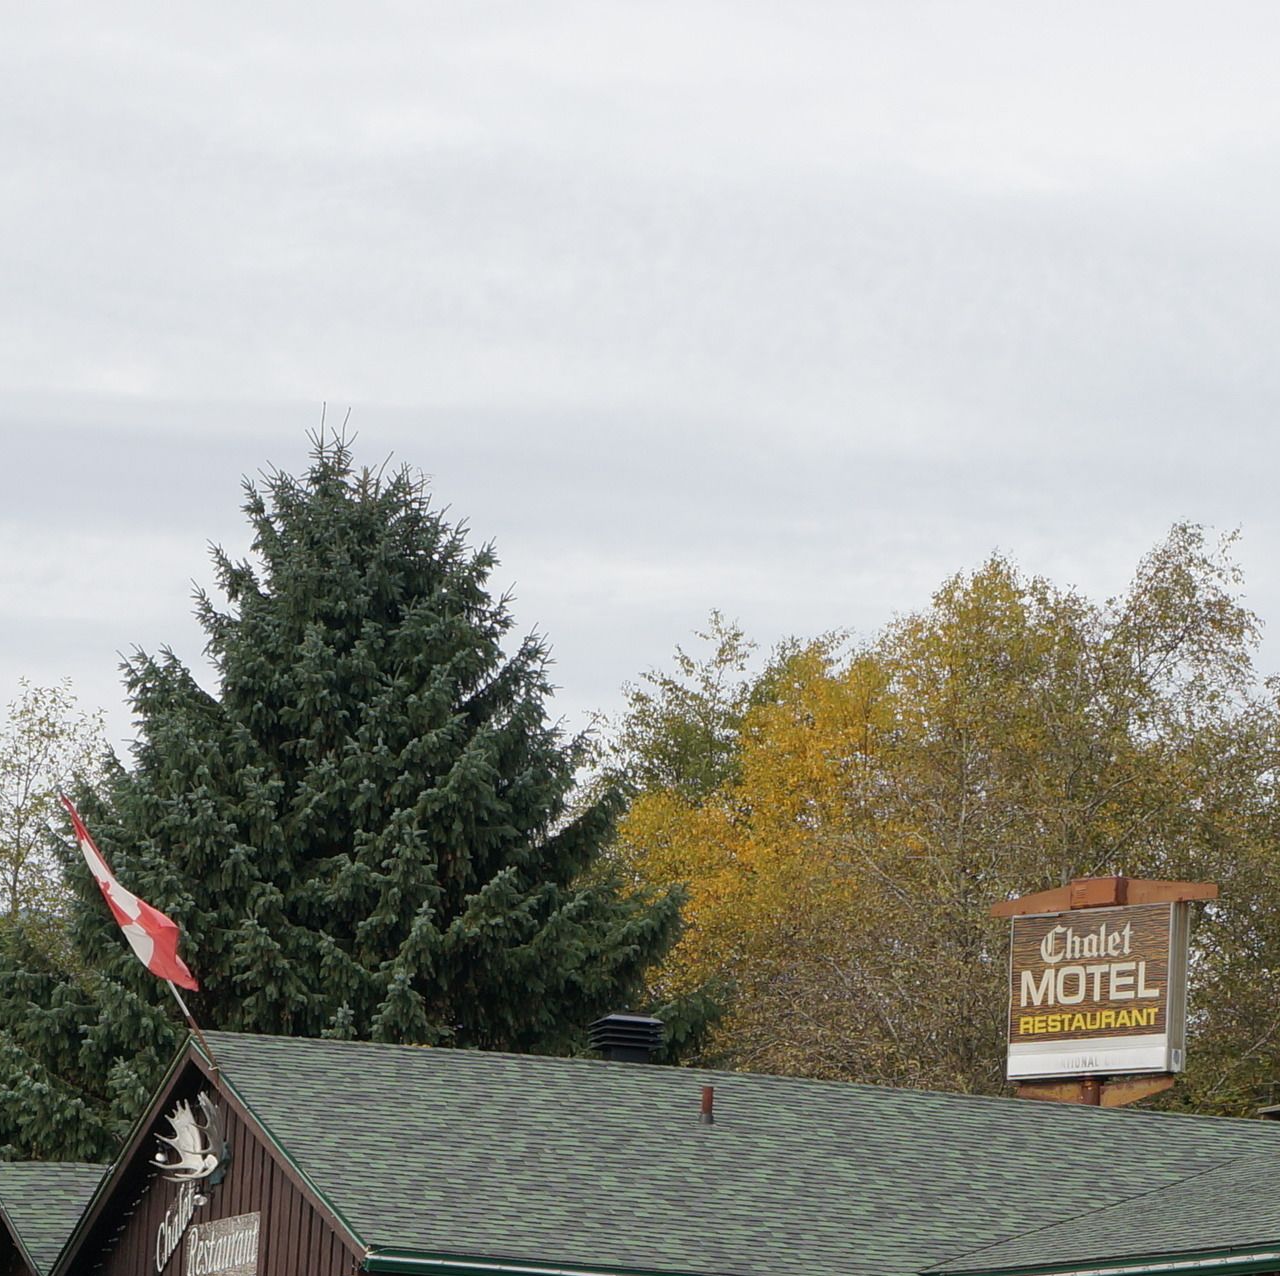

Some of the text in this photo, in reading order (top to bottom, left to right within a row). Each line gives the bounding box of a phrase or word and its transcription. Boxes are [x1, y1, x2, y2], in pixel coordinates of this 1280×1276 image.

[1040, 921, 1134, 964] Chalet
[1020, 961, 1159, 1007] MOTEL
[1020, 1008, 1159, 1035] RESTAURANT
[156, 1180, 195, 1273] Chalet
